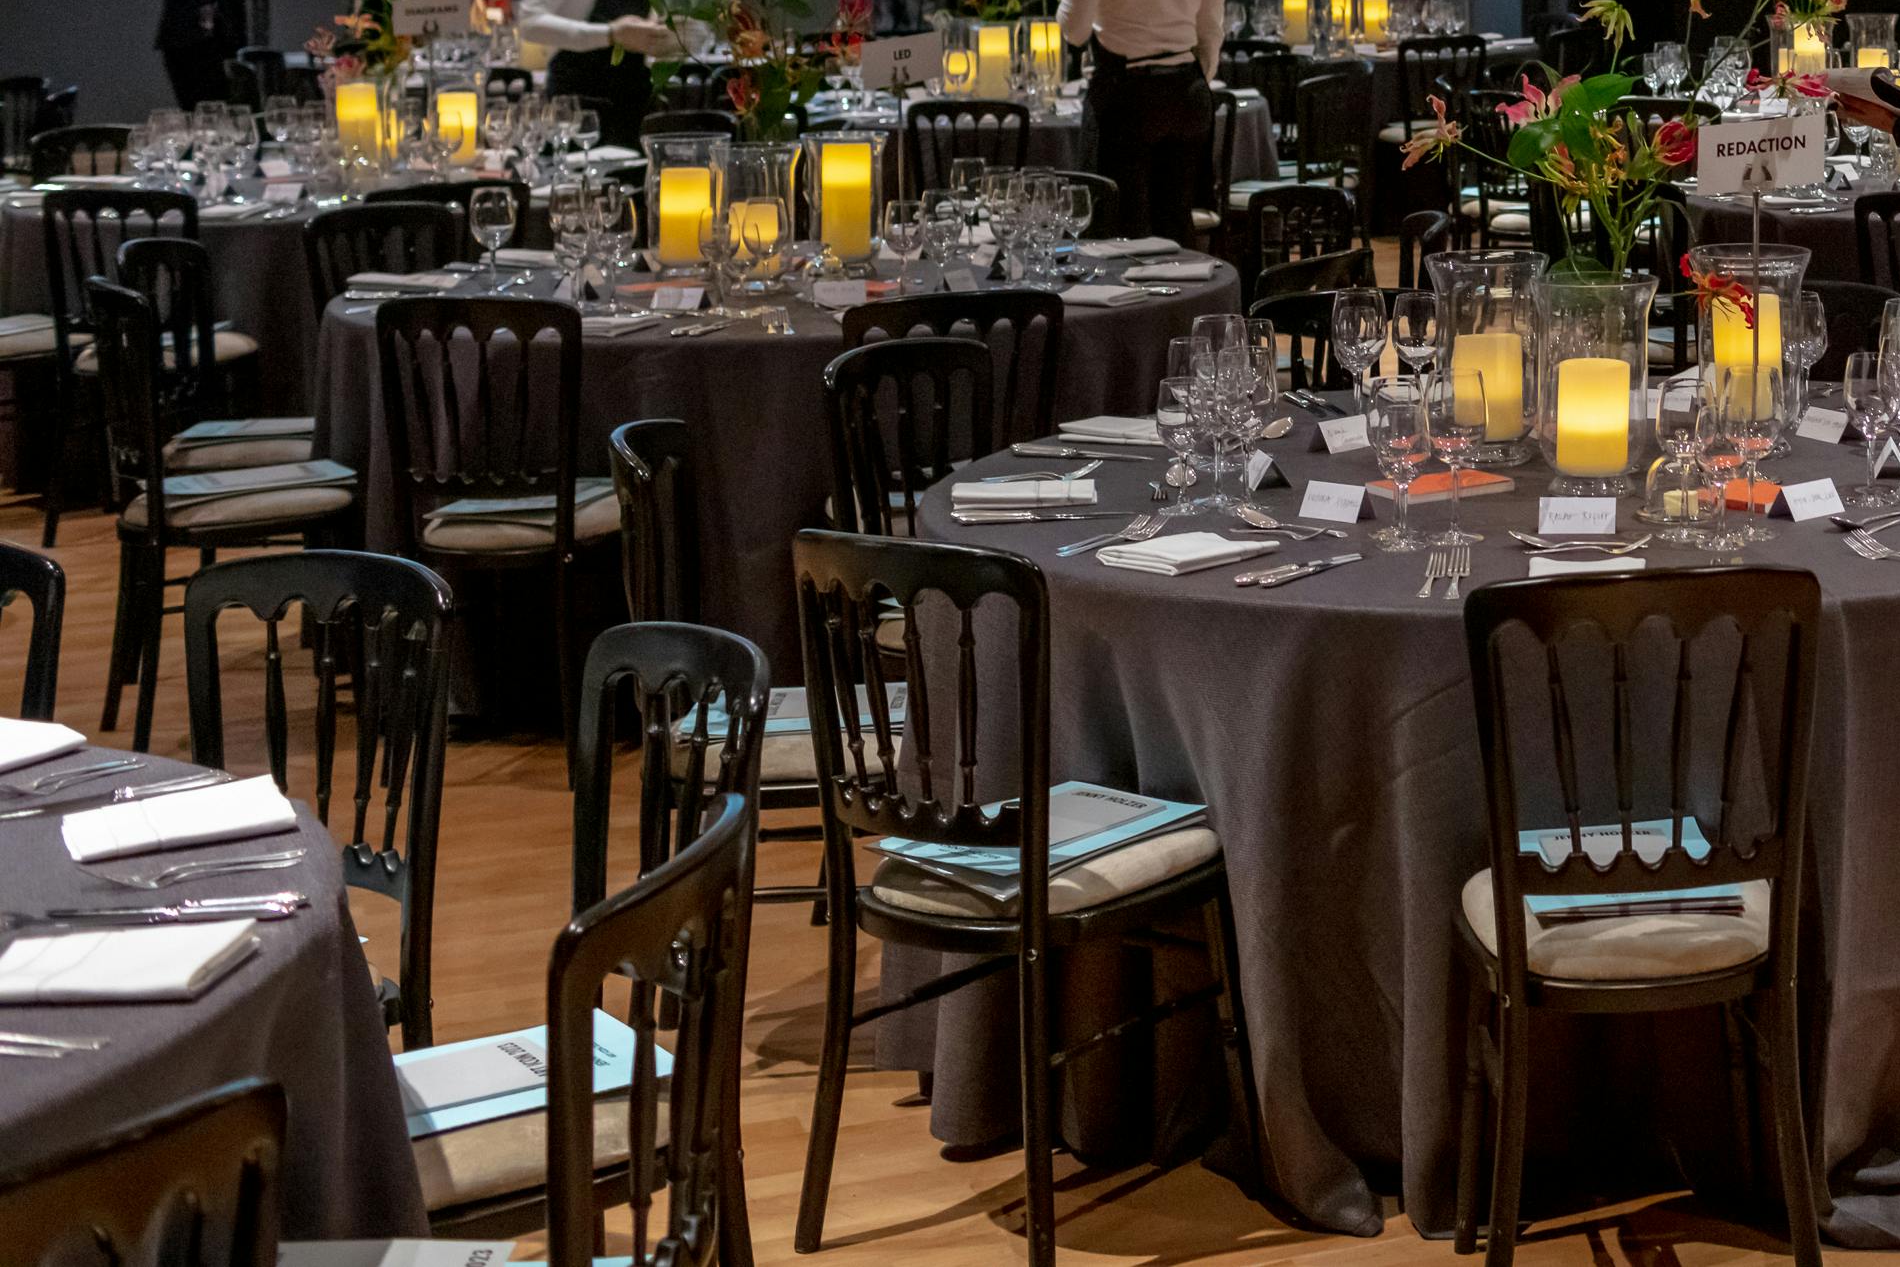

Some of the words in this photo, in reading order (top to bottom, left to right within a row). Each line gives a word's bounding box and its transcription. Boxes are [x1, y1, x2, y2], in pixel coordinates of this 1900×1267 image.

[893, 48, 912, 61] LED
[1716, 135, 1806, 158] REDACTION
[1104, 796, 1148, 809] HOLZER
[1599, 830, 1651, 838] HOER
[497, 1042, 526, 1056] 2023
[465, 1249, 493, 1267] 023
